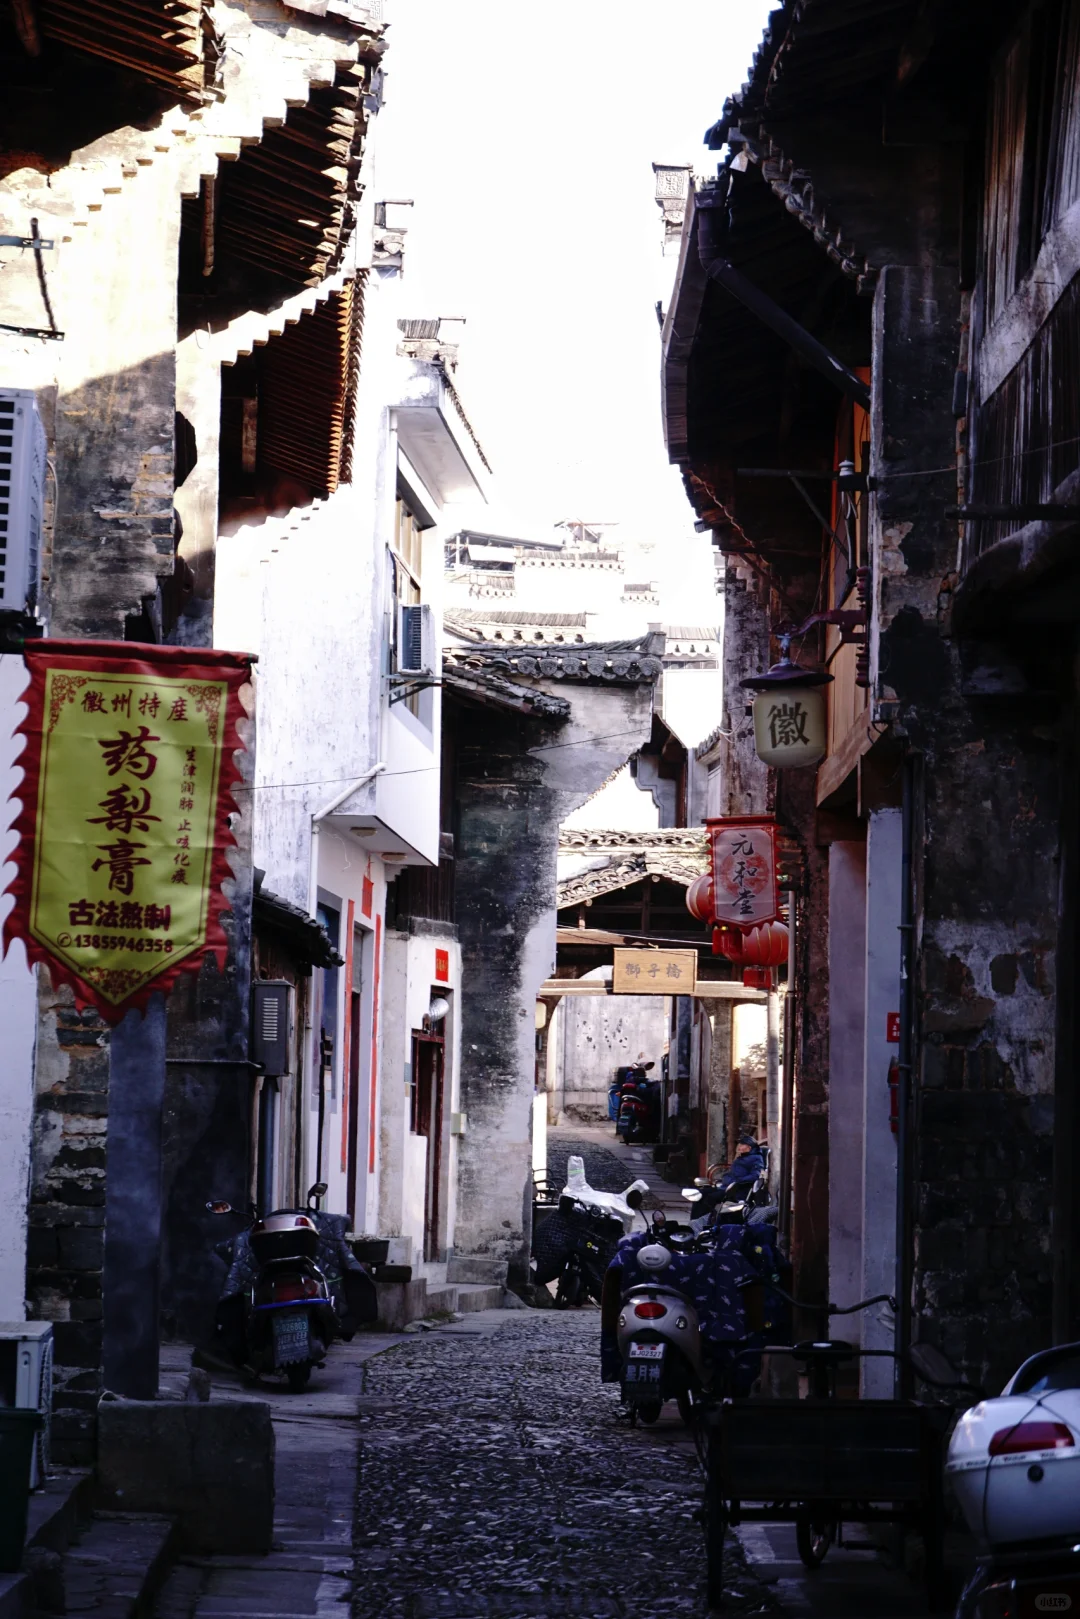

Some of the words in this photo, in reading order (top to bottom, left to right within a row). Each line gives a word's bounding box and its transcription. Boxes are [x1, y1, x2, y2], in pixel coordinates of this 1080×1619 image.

[767, 701, 810, 749] 徽
[86, 725, 162, 896] 药梨膏
[178, 746, 197, 814] 生津润肺
[170, 818, 192, 886] 止咳化痰
[731, 832, 758, 915] 元和堂
[68, 898, 172, 932] 古法熬制
[73, 934, 174, 953] 13855946358
